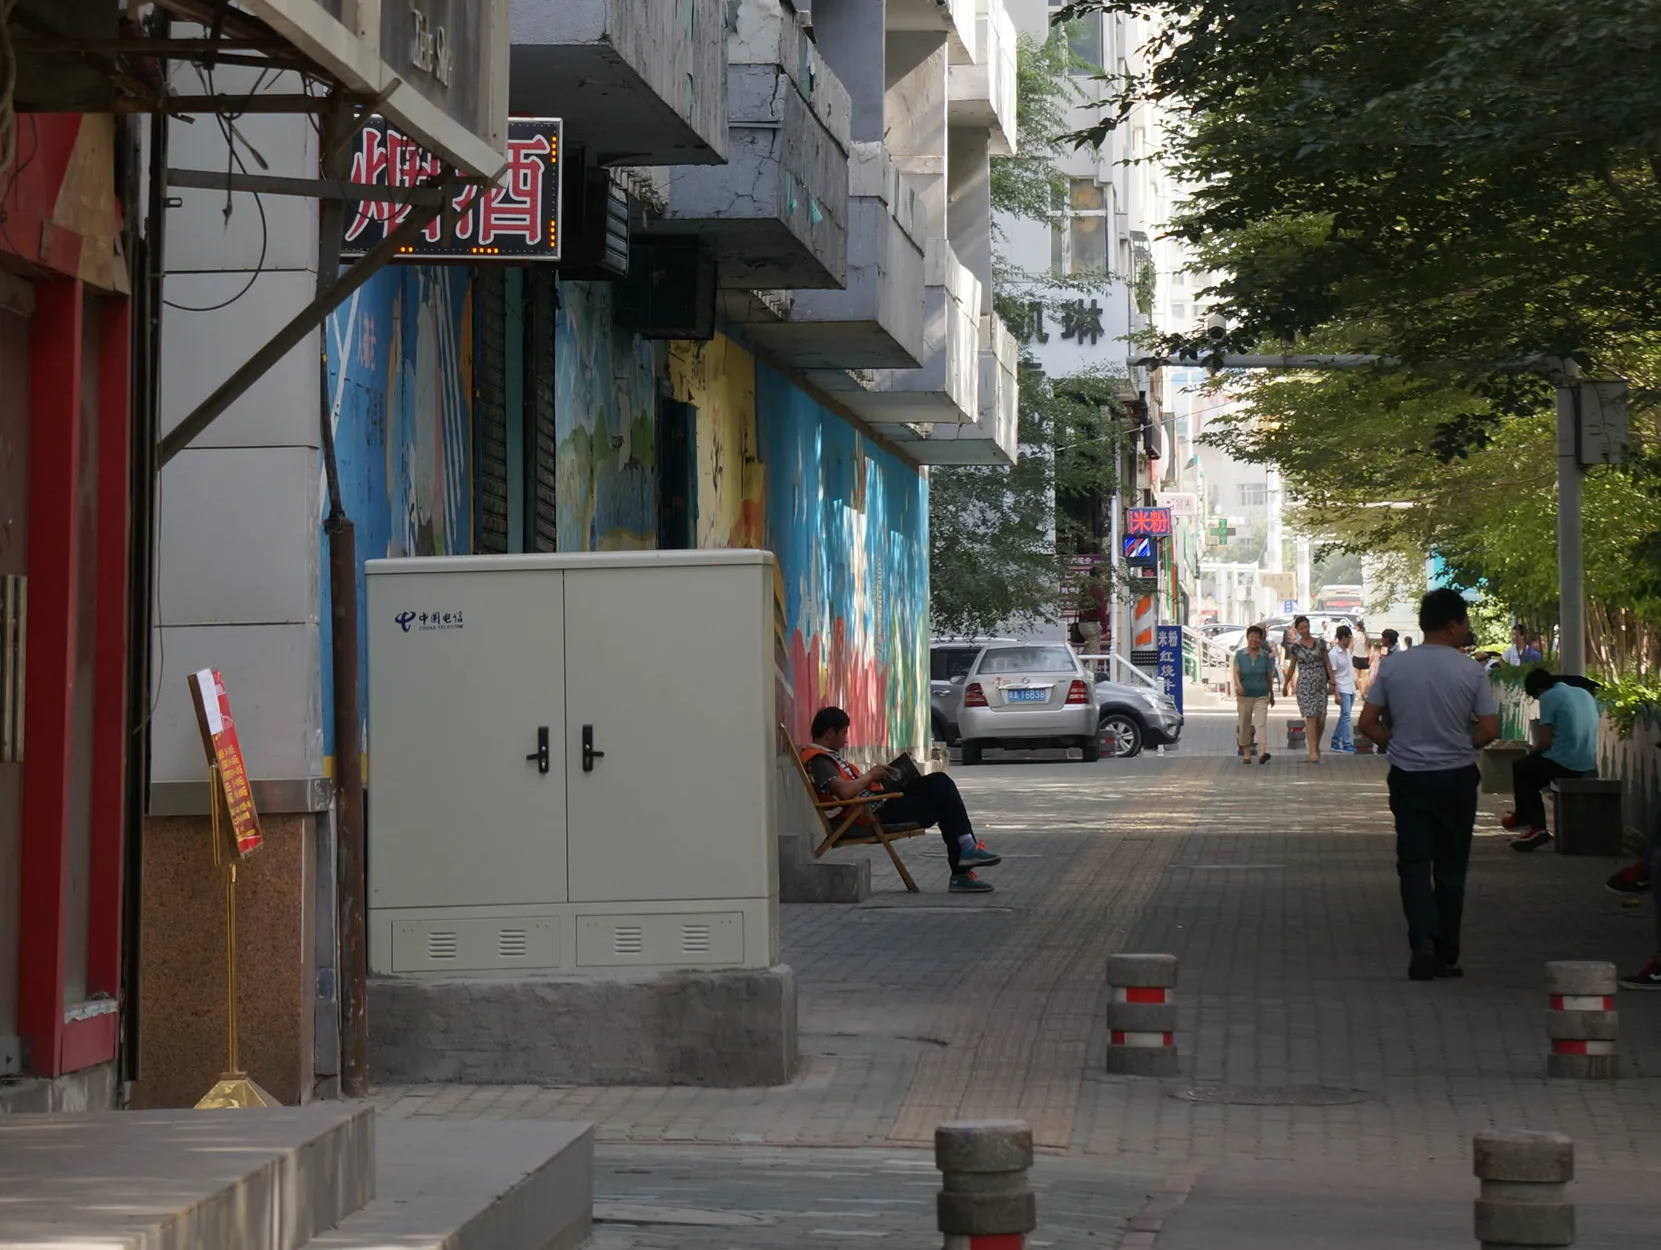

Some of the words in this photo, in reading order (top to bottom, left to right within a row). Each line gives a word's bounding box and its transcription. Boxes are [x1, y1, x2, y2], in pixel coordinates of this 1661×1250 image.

[345, 128, 550, 245] 烟酒
[1131, 510, 1168, 533] 米粉
[419, 610, 463, 625] 中国电信
[1158, 630, 1178, 647] 米粉
